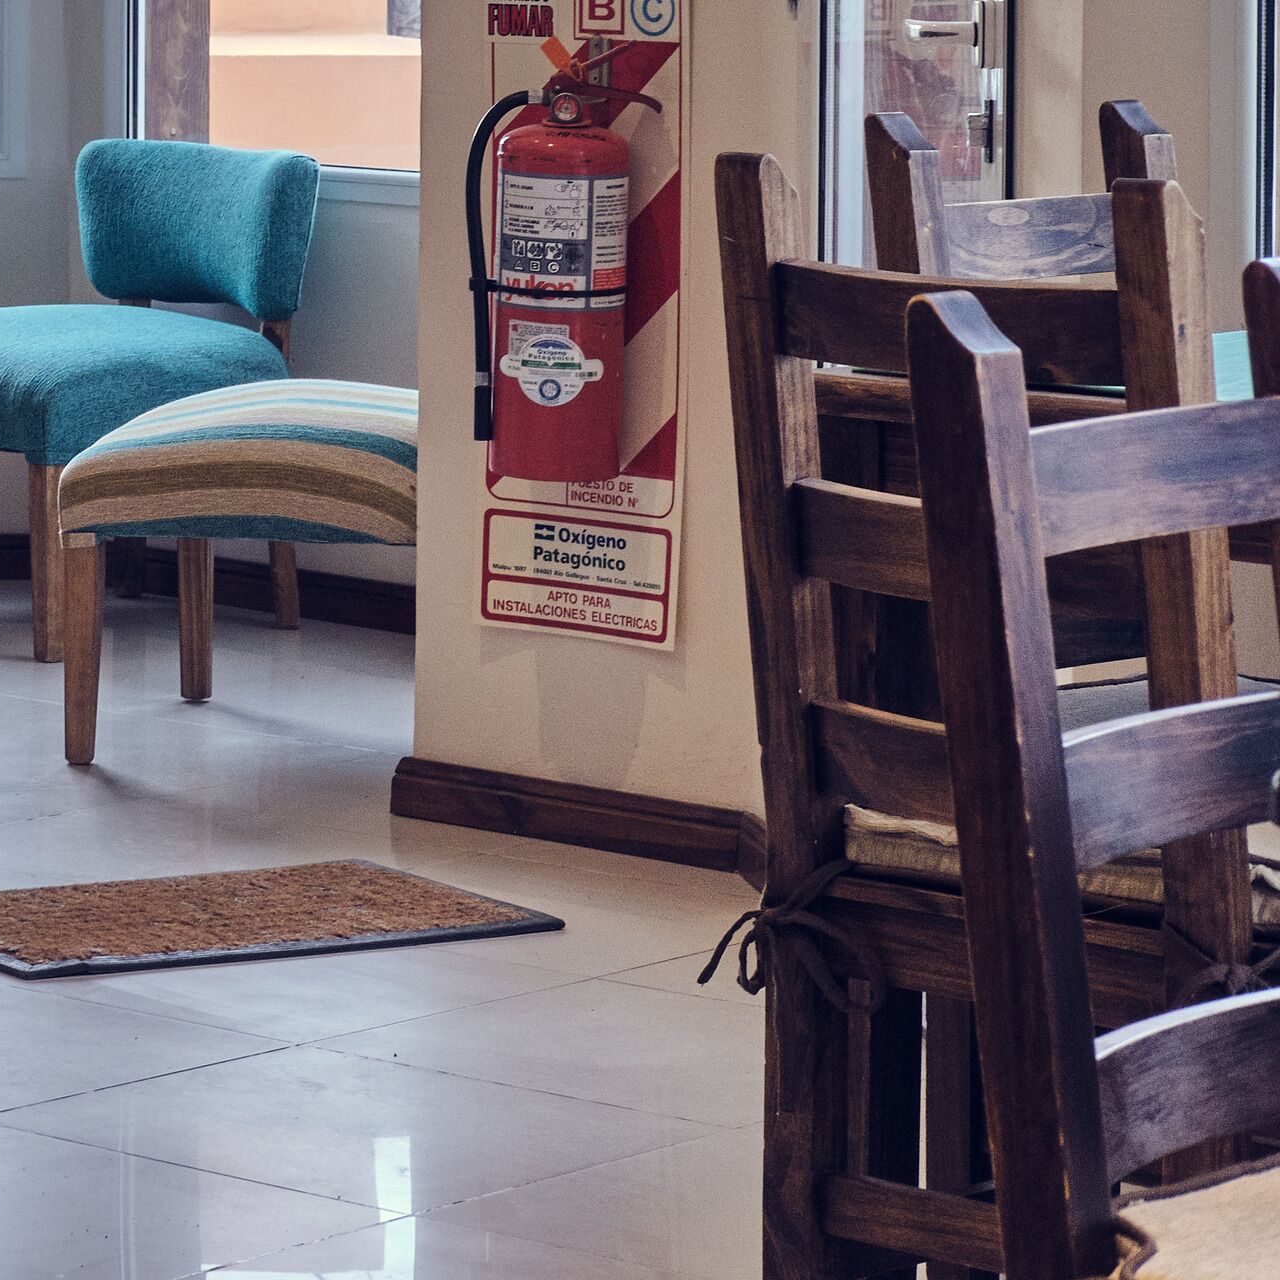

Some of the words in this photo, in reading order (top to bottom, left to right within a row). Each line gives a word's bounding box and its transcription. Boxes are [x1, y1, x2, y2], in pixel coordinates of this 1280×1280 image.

[487, 3, 554, 38] FUMAR
[571, 490, 624, 506] INCENDIO
[619, 482, 634, 493] DE
[558, 527, 627, 550] Oxígeno
[533, 545, 626, 571] Patagónico
[547, 590, 578, 605] APTO
[582, 596, 611, 609] PARA
[493, 598, 586, 621] INSTALACIONES
[591, 611, 658, 632] ELECTRICAS
